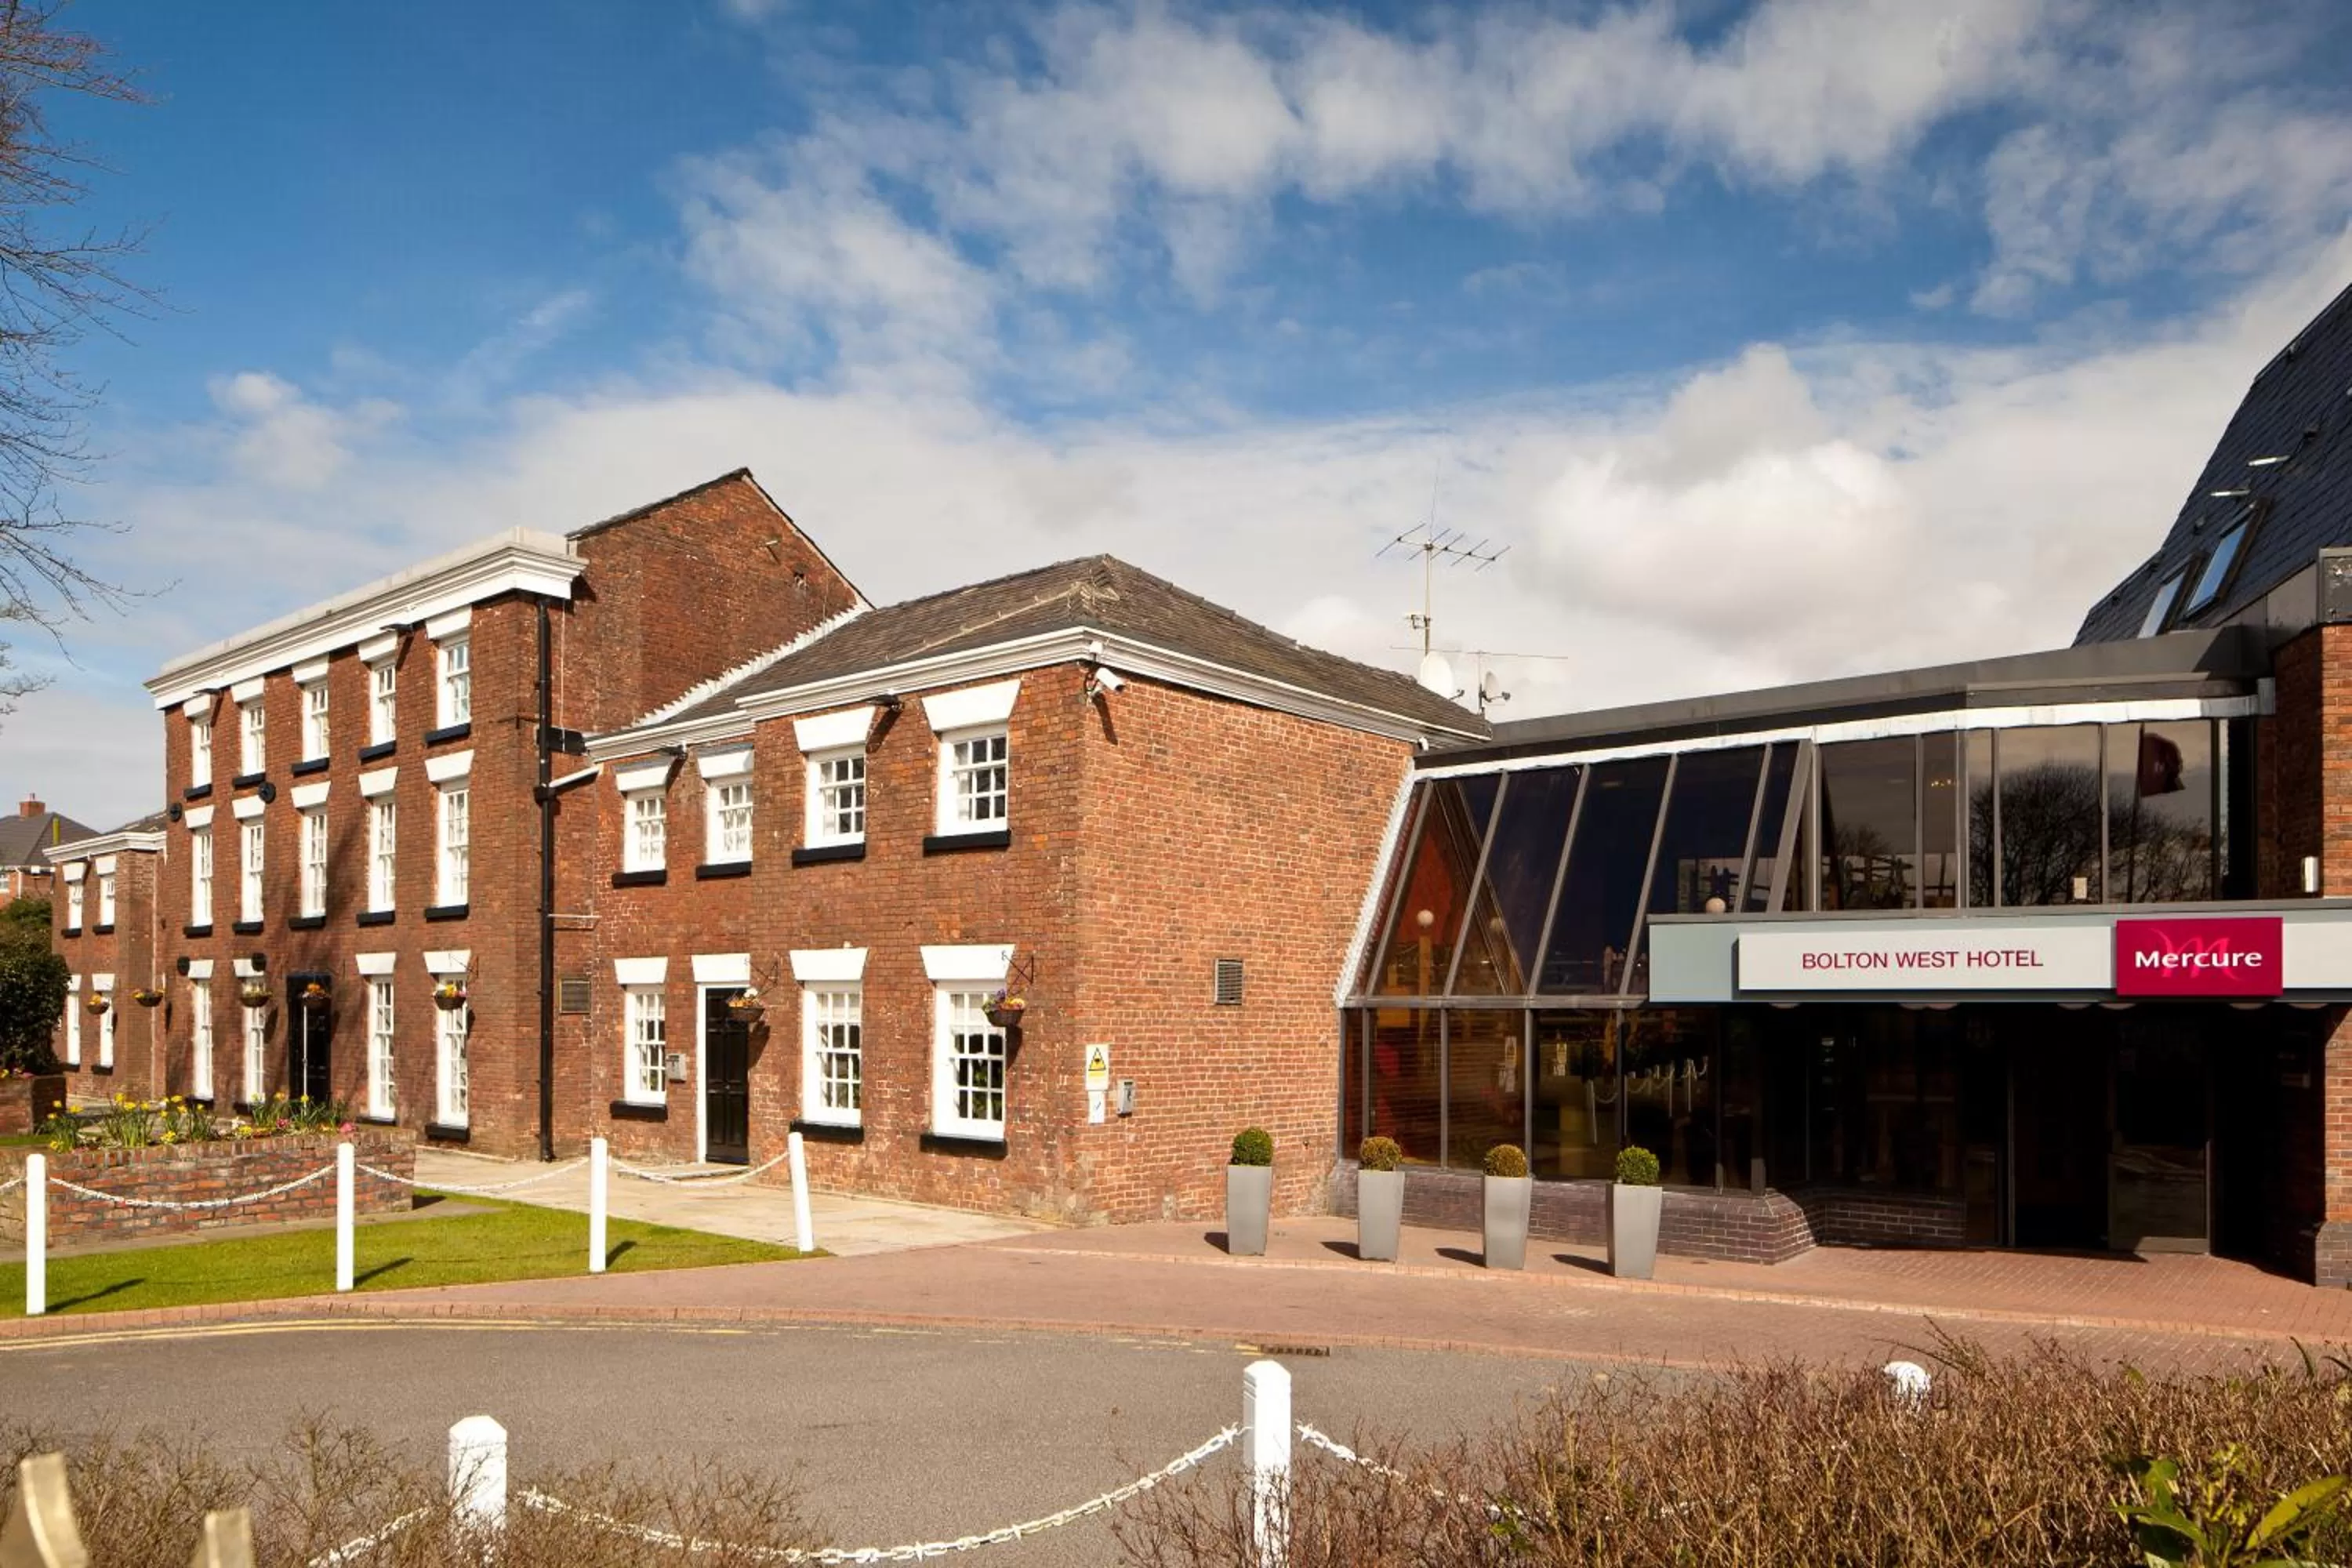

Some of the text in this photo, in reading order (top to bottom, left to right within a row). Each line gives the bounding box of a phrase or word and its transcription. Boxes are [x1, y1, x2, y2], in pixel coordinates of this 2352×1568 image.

[1802, 949, 2044, 970] BOLTON WEST HOTEL
[2135, 950, 2263, 968] Mercure
